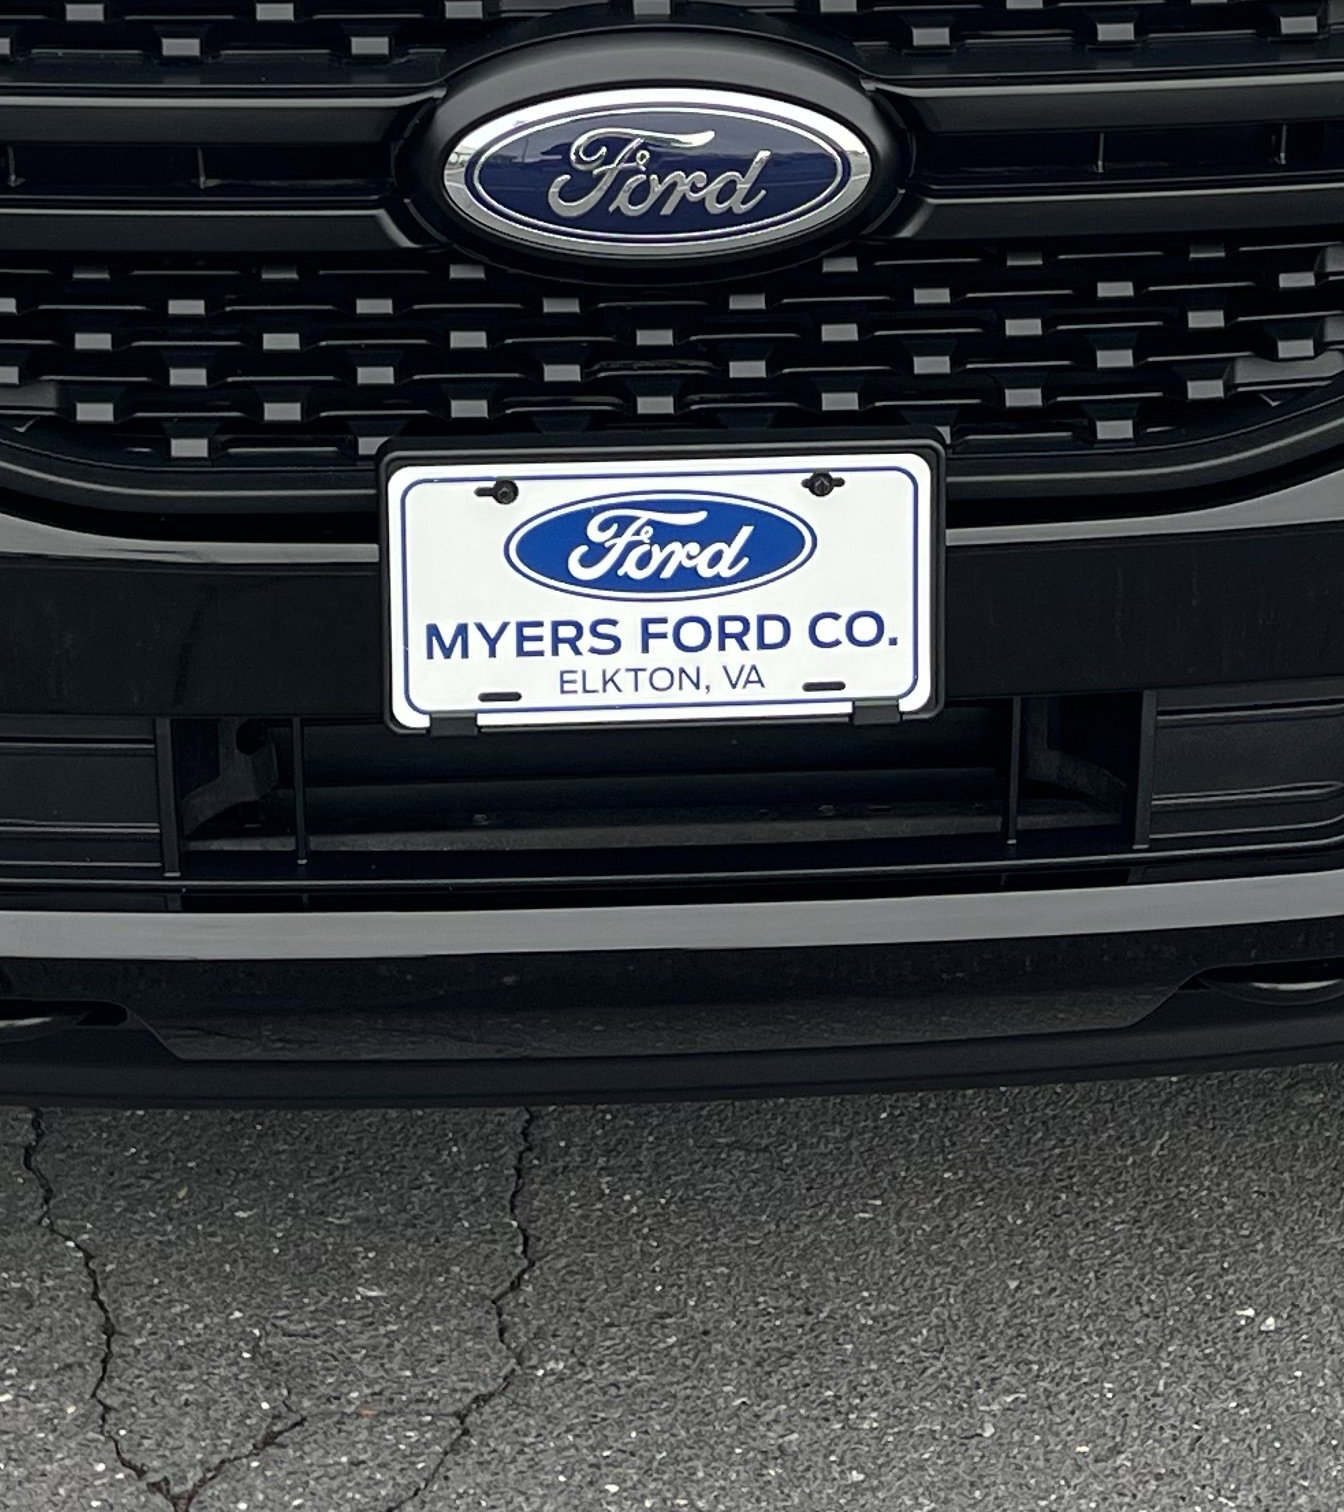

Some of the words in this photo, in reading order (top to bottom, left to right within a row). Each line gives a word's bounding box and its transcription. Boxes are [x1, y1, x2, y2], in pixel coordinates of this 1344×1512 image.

[548, 127, 771, 218] Ford
[567, 507, 756, 581] Ford
[425, 618, 622, 659] MYERS
[640, 614, 791, 654] FORD
[807, 610, 898, 648] CO.
[558, 665, 711, 696] ELKTON,
[722, 664, 765, 690] VA
